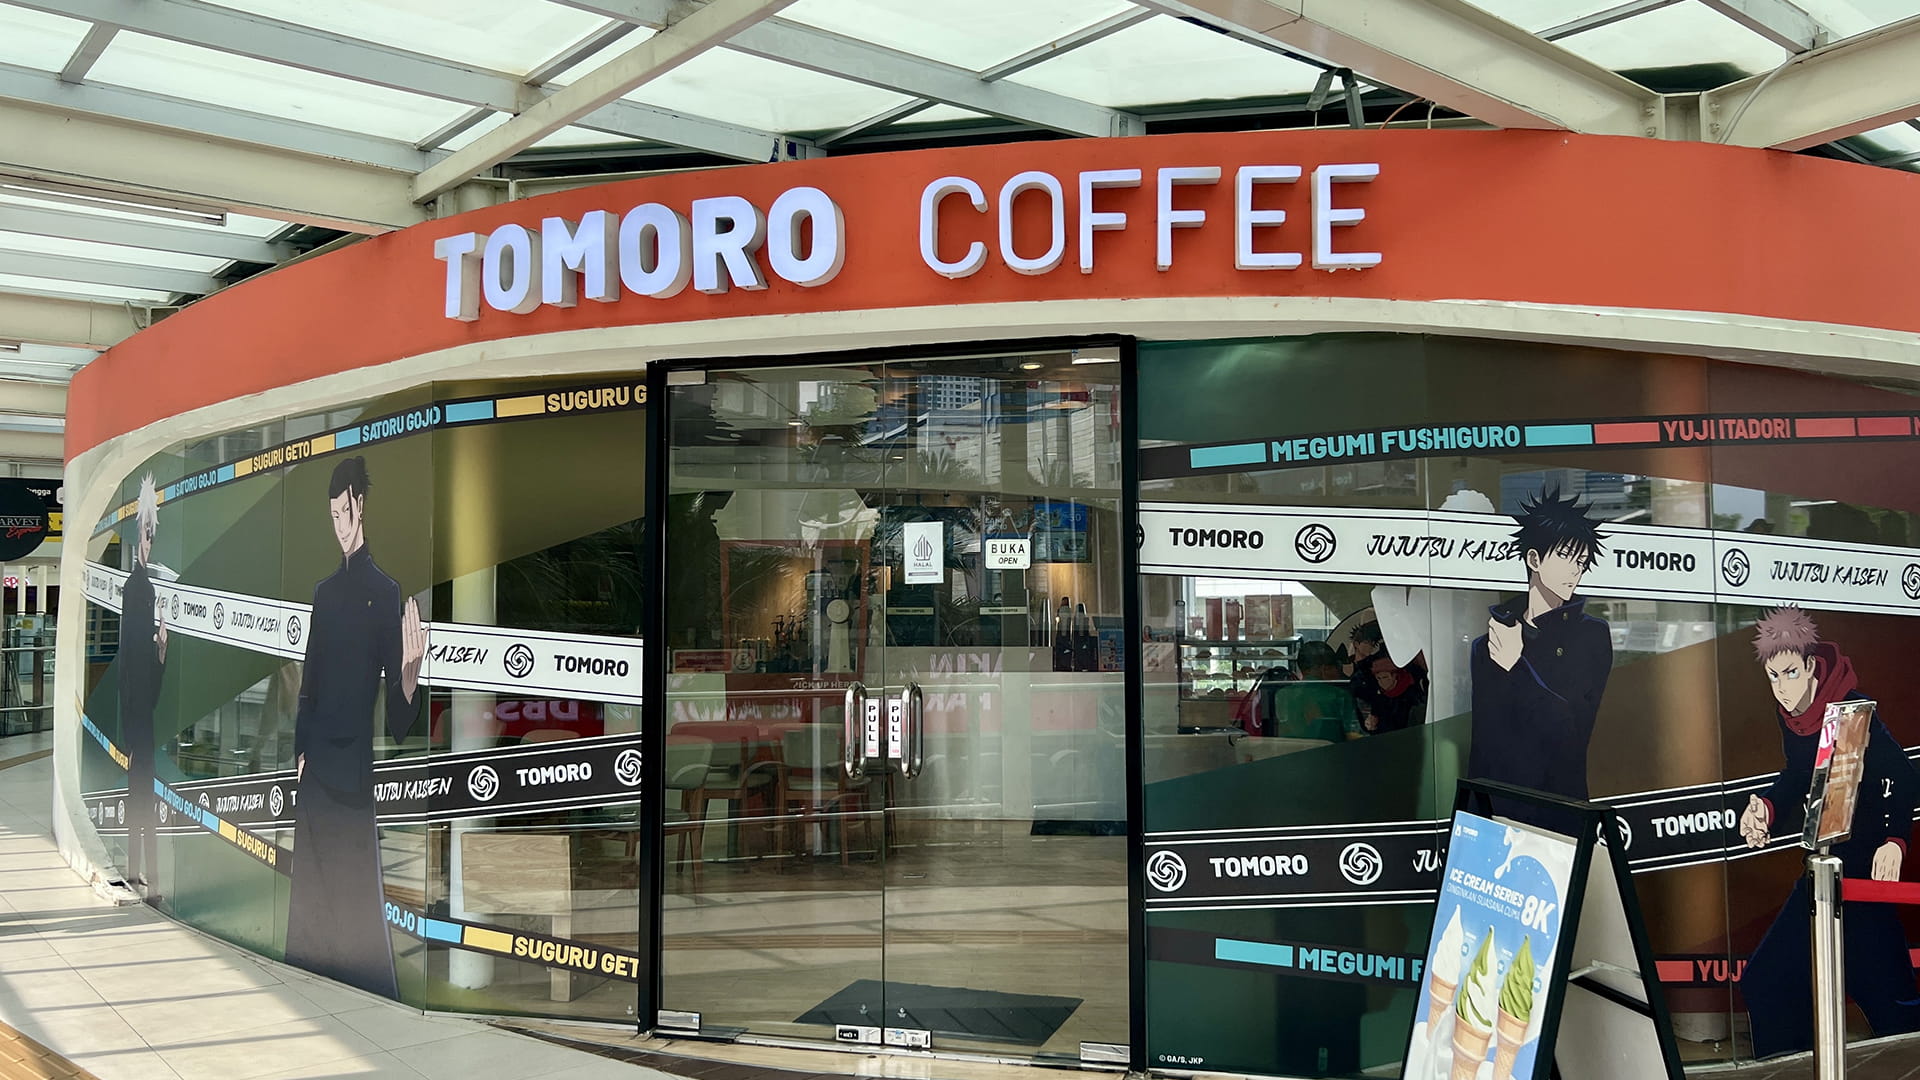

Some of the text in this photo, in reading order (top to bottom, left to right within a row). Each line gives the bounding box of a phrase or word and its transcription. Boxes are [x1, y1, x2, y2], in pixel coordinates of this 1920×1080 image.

[434, 163, 1382, 322] TOMORO COFFEE
[547, 386, 630, 413] SUGURU
[362, 406, 441, 443] SATORU GOJO
[1663, 417, 1790, 442] YUJI ITADORI
[252, 441, 310, 473] SUGURU GETO
[1272, 425, 1520, 463] MEGUMI FUSHIGURO
[174, 469, 217, 497] SATORU GOJO
[991, 543, 1025, 554] BUKA
[998, 557, 1018, 565] OPEN
[1169, 527, 1889, 587] TOMORO JUJUTSU KAISE TOMORO JUJUTSU KAISEN
[183, 604, 207, 619] TOMORO
[425, 644, 630, 677] KAISEN TOMORO
[868, 705, 876, 742] PULL
[891, 705, 899, 742] PULL
[403, 777, 453, 801] KAISEN
[516, 762, 593, 787] TOMORO
[183, 801, 202, 823] GOJO
[237, 829, 268, 860] SUGURU
[1651, 809, 1737, 838] TOMORO
[1209, 854, 1309, 878] TOMORO
[1449, 868, 1525, 908] ICE CREAM SERIES
[1520, 894, 1556, 935] 8K
[384, 901, 416, 932] GOJO
[514, 936, 597, 970] SUGURU
[1299, 947, 1405, 981] MEGUMI
